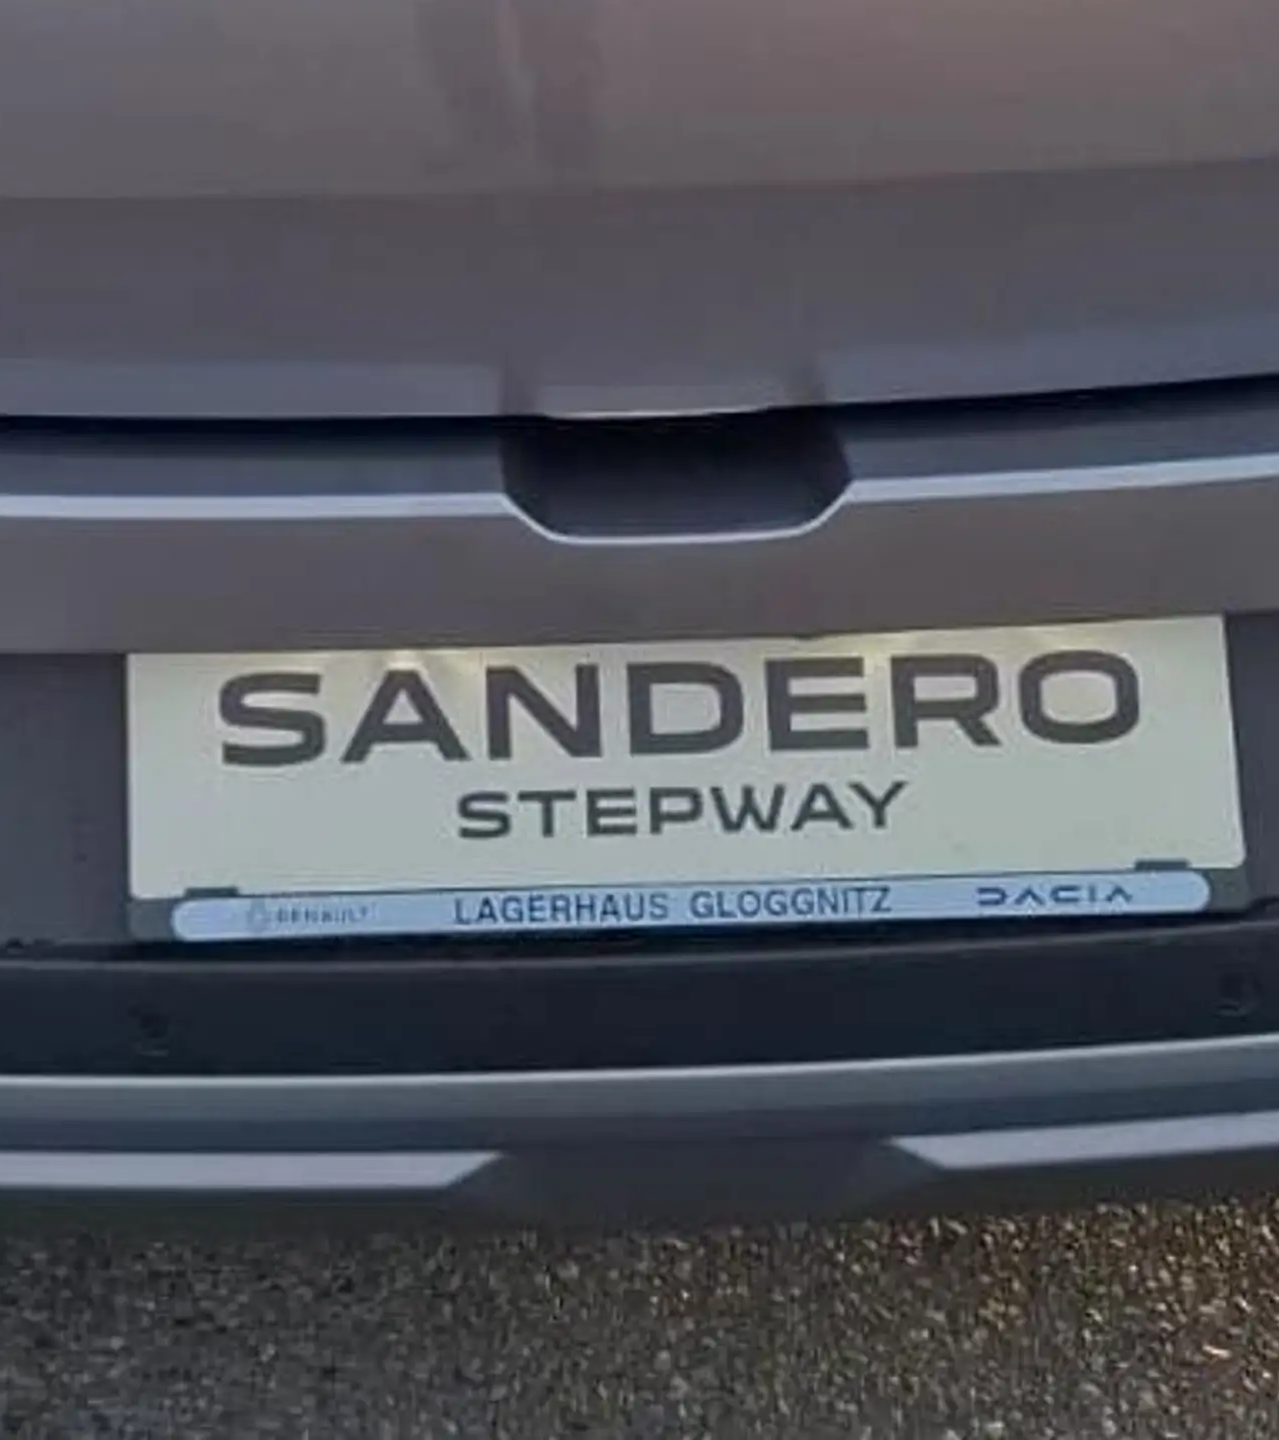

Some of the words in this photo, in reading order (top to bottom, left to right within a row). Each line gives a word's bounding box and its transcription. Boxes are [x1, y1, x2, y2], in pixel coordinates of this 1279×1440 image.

[218, 650, 1140, 767] SANDERO
[457, 779, 908, 840] STEPWAY
[454, 892, 669, 926] LAGERHAUS
[689, 884, 893, 919] GLOGGNITZ
[975, 882, 1134, 907] DACIA
